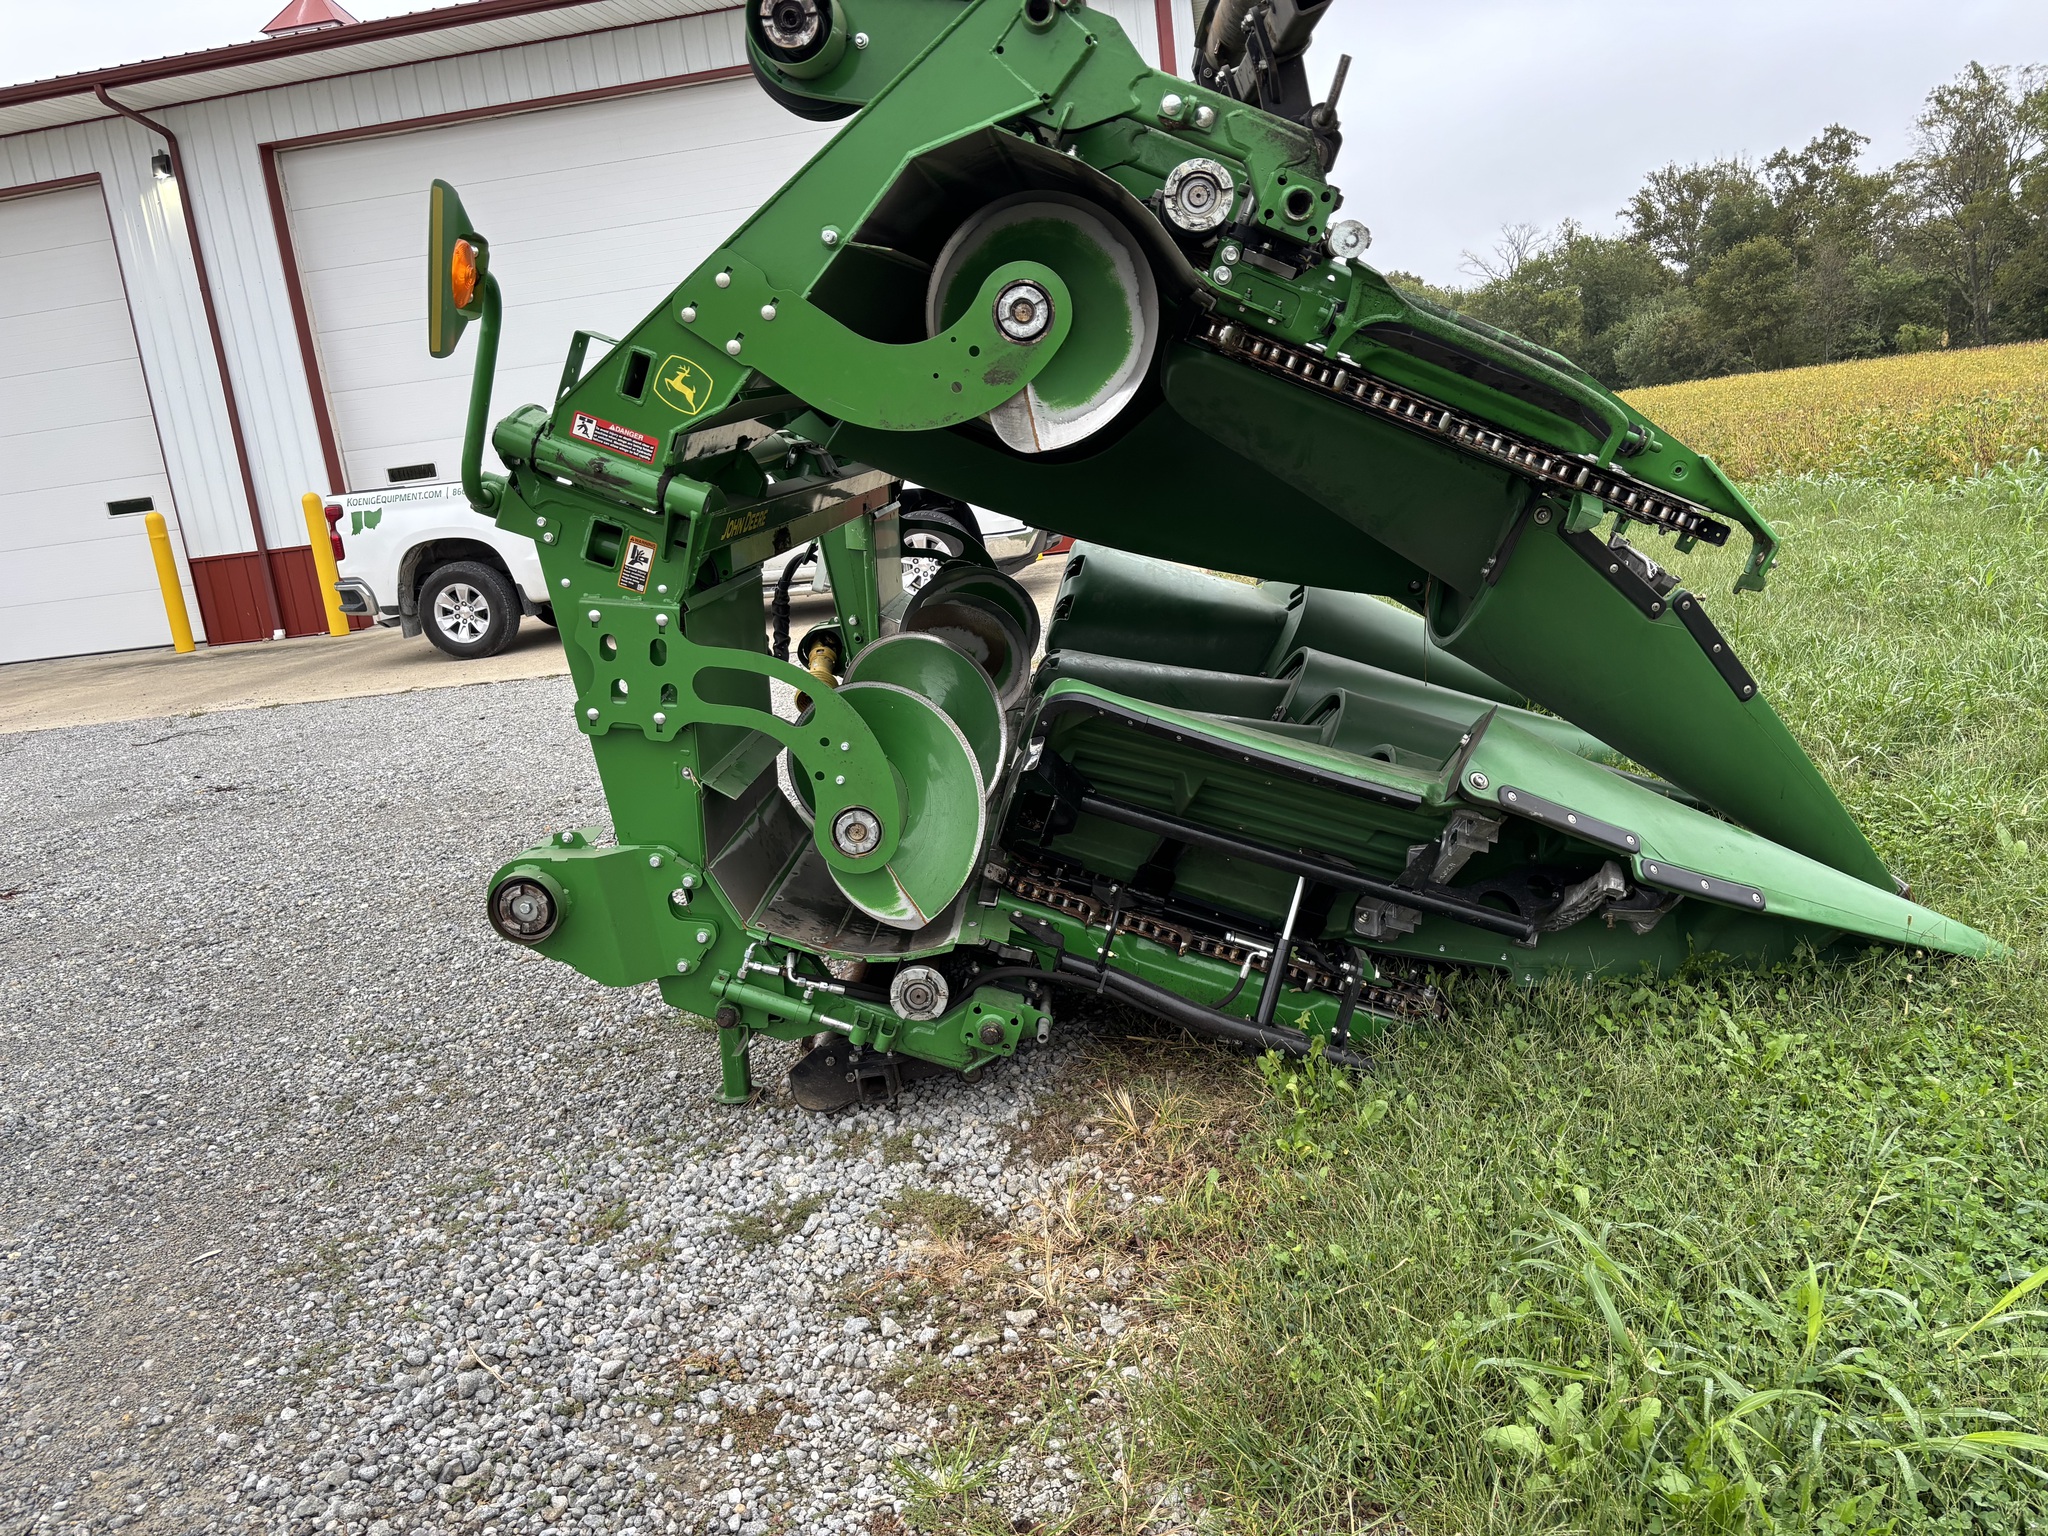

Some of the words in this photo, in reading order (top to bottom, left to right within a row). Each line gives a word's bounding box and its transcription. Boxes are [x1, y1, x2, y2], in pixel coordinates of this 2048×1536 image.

[614, 425, 644, 441] DANGER
[721, 516, 745, 540] JOHN
[743, 509, 769, 533] DEERE
